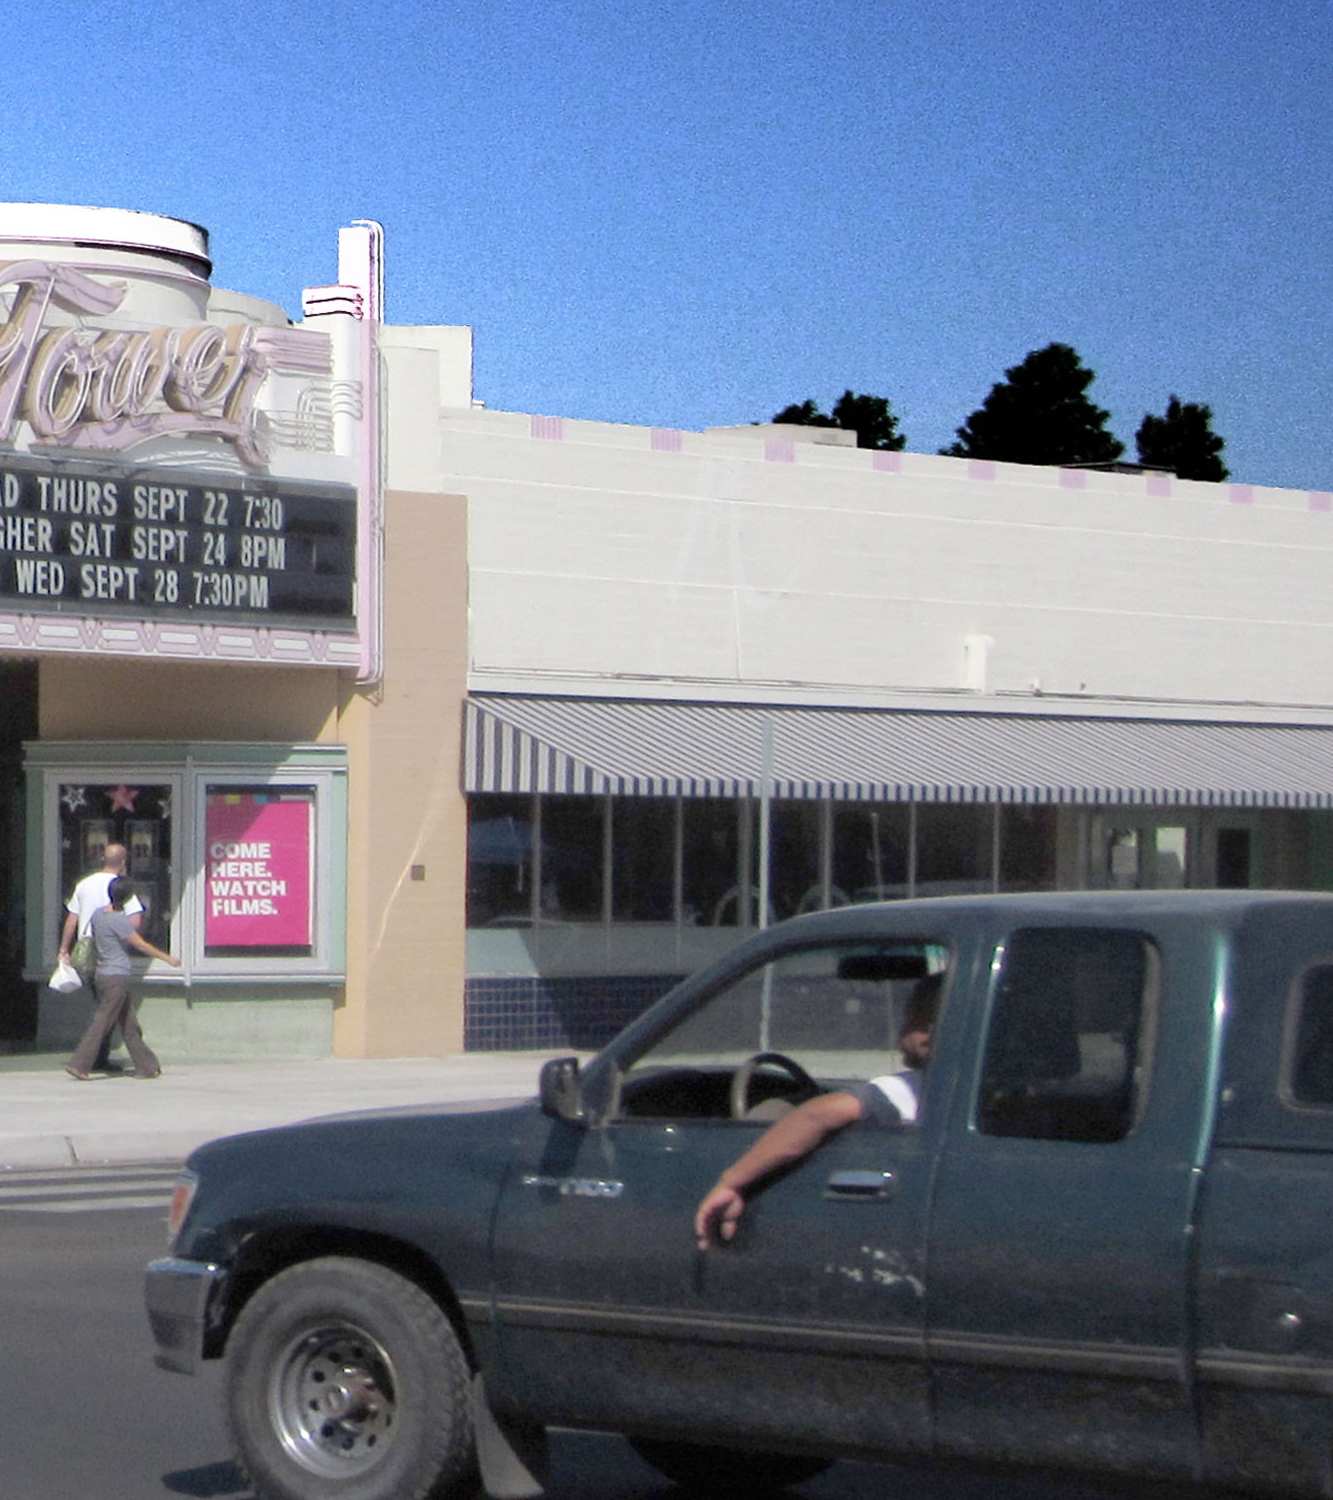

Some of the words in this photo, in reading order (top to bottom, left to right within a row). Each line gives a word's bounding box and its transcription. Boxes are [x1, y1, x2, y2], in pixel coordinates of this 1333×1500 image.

[37, 476, 118, 517] THURS
[133, 485, 189, 522] SEPT
[203, 491, 229, 527] 22
[243, 496, 283, 531] 7:30
[69, 521, 115, 558] SAT
[133, 526, 188, 563] SEPT
[203, 532, 226, 566] 24
[241, 535, 286, 570] 8PM
[15, 559, 65, 596] WED
[81, 564, 139, 601] SEPT
[154, 569, 179, 604] 28
[193, 572, 269, 609] 7:30PM
[210, 843, 272, 859] COME
[211, 861, 273, 878] HERE.
[210, 880, 287, 897] WATCH
[211, 898, 279, 917] FILMS.
